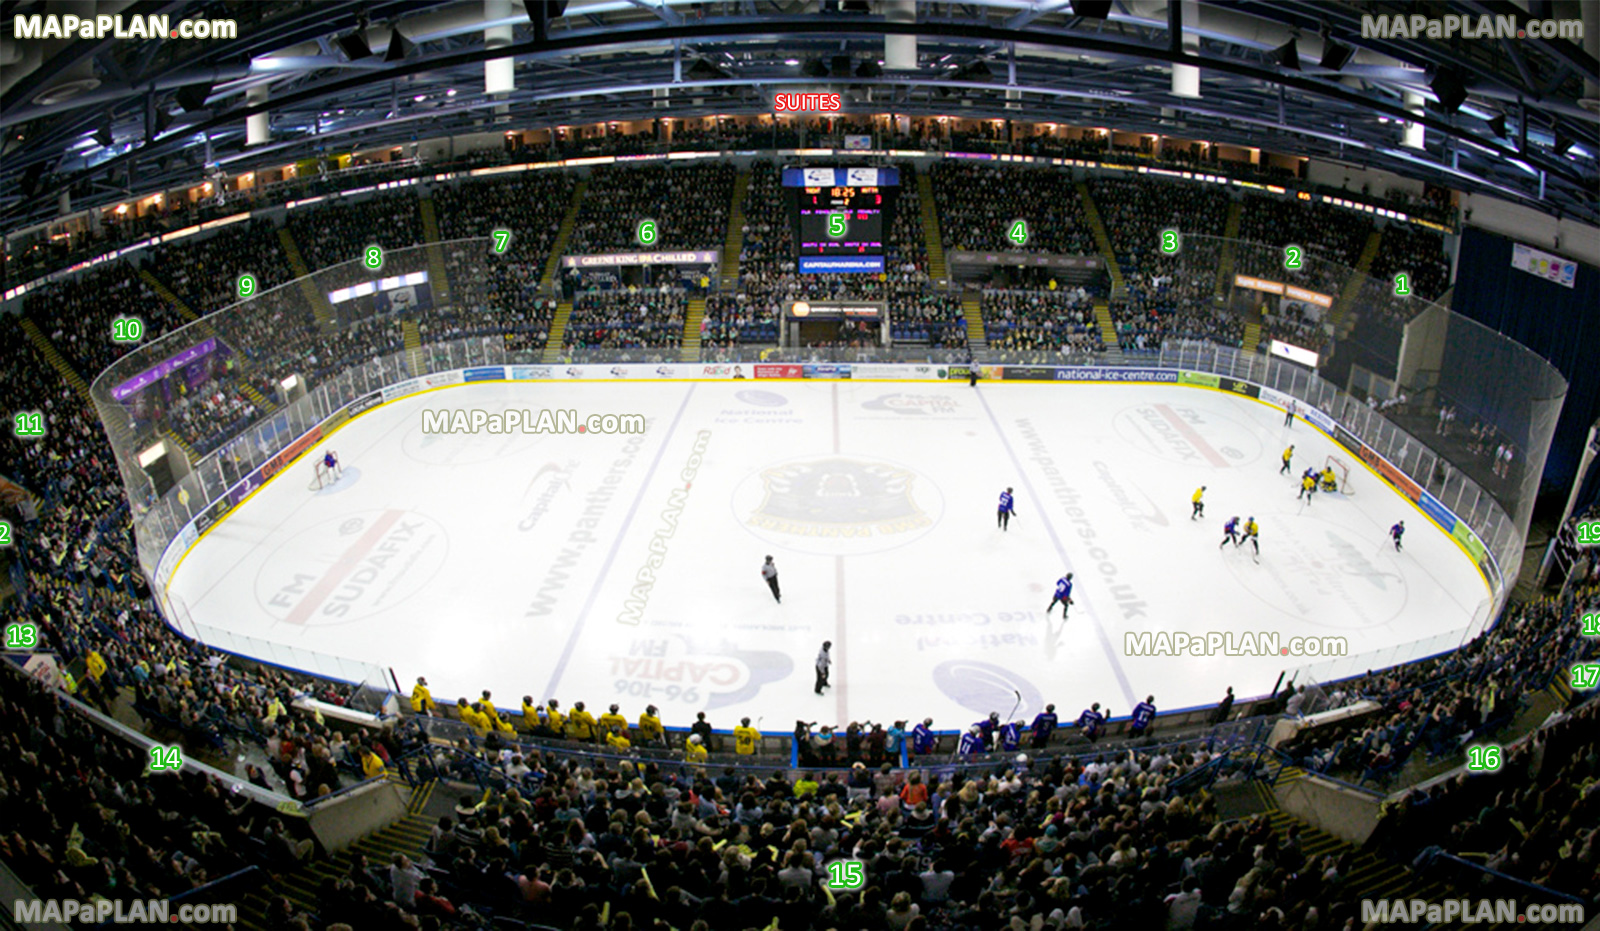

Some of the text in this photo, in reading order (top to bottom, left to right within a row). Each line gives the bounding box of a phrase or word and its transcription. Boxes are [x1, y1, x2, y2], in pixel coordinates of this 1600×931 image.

[615, 255, 638, 264] KING
[653, 253, 697, 264] CHILLED
[1057, 368, 1177, 382] national-ice-centre.com
[746, 515, 873, 538] PANTHERS
[1015, 417, 1148, 620] www.panthers.co.uk
[322, 520, 425, 618] SUDAFIX
[267, 573, 318, 609] FM
[608, 656, 741, 686] CAPITAL
[613, 679, 700, 704] 96-106
